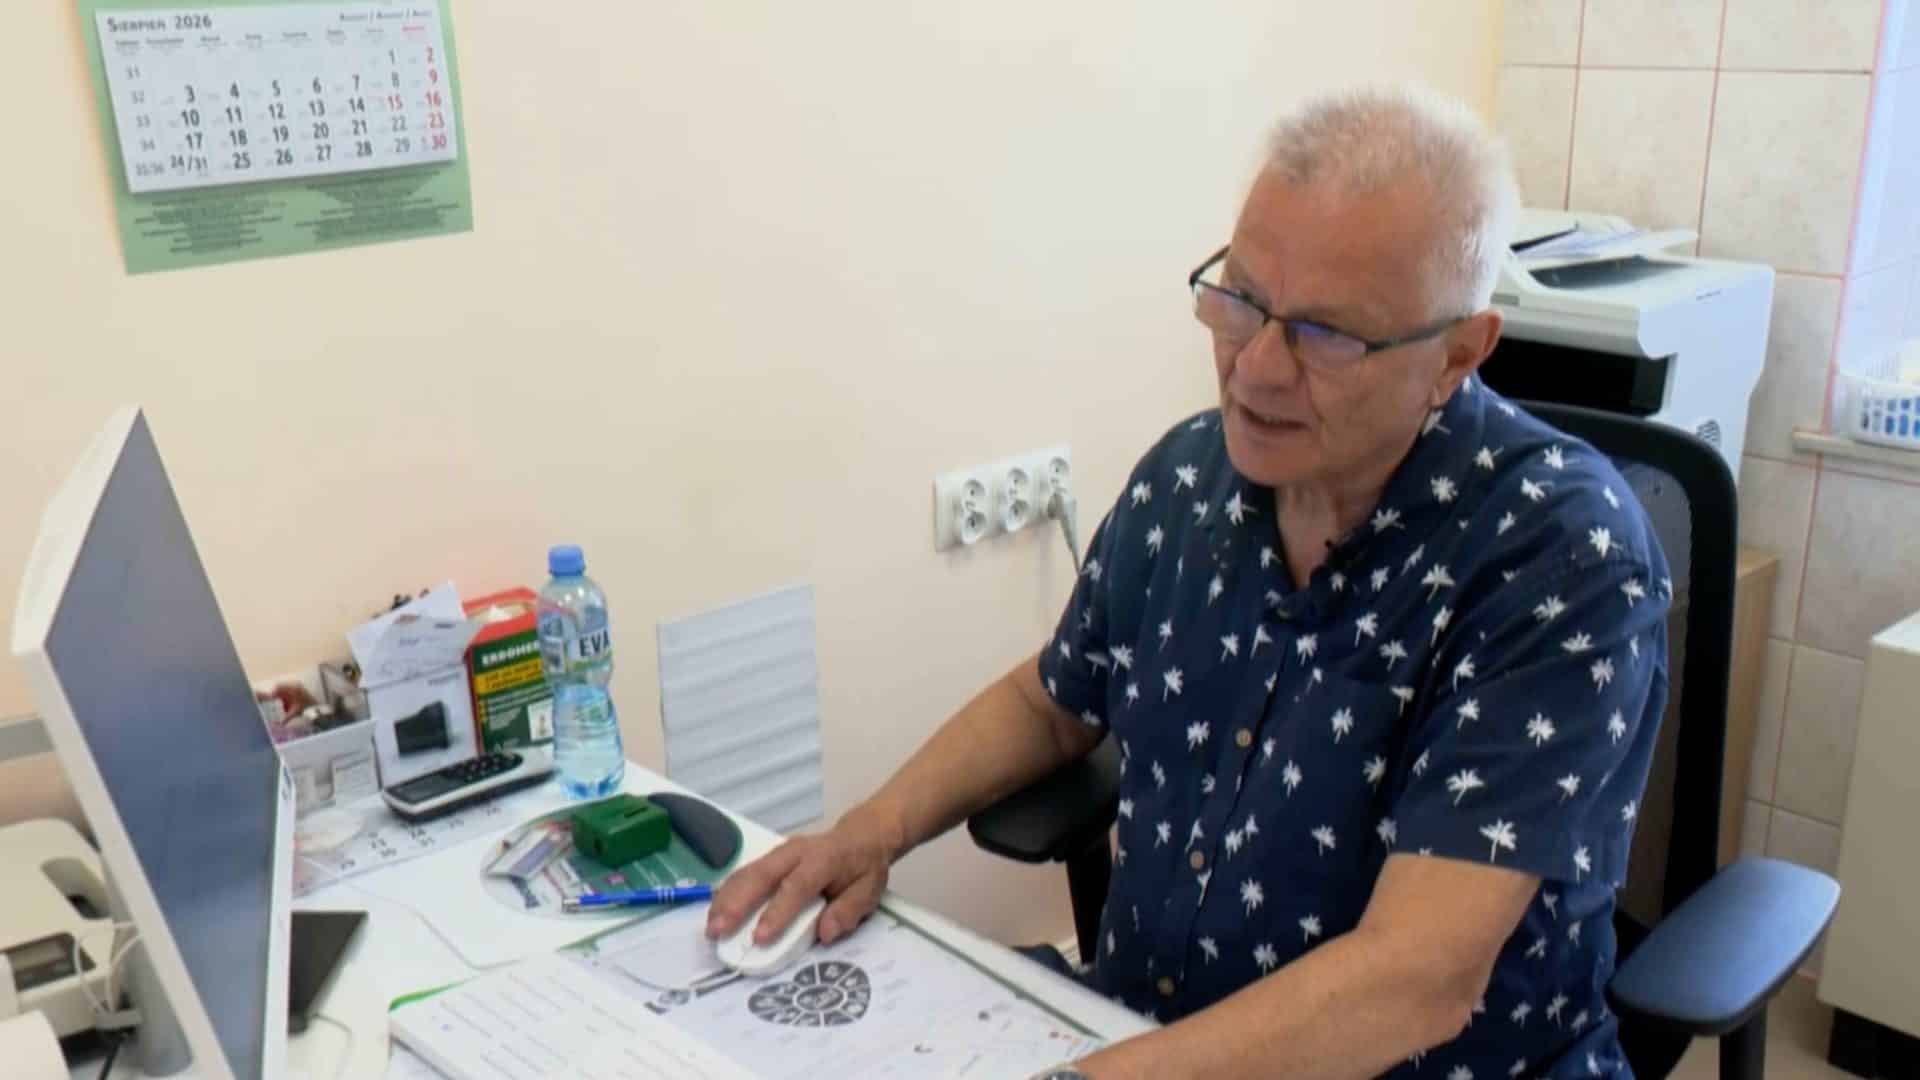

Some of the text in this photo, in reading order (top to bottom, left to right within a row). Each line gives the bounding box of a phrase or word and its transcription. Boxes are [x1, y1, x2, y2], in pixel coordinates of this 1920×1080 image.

[175, 14, 212, 30] 2026
[426, 46, 434, 63] 2
[184, 84, 195, 103] 3
[230, 82, 240, 99] 4
[272, 79, 281, 97] 5
[313, 76, 322, 94] 6
[352, 74, 360, 91] 7
[391, 72, 400, 89] 8
[429, 68, 438, 85] 9
[181, 108, 200, 127] 10
[225, 106, 243, 124] 11
[269, 103, 286, 120] 12
[309, 99, 326, 117] 13
[349, 97, 365, 113] 14
[388, 93, 403, 111] 15
[426, 90, 442, 108] 16
[186, 132, 203, 150] 17
[230, 129, 248, 147] 18
[273, 125, 289, 143] 19
[313, 122, 329, 140] 20
[352, 119, 367, 136] 21
[392, 115, 407, 133] 22
[429, 112, 445, 129] 23
[232, 151, 250, 170] 25
[275, 148, 293, 165] 26
[316, 144, 332, 162] 27
[355, 140, 373, 158] 28
[394, 136, 410, 153] 29
[431, 134, 447, 151] 30
